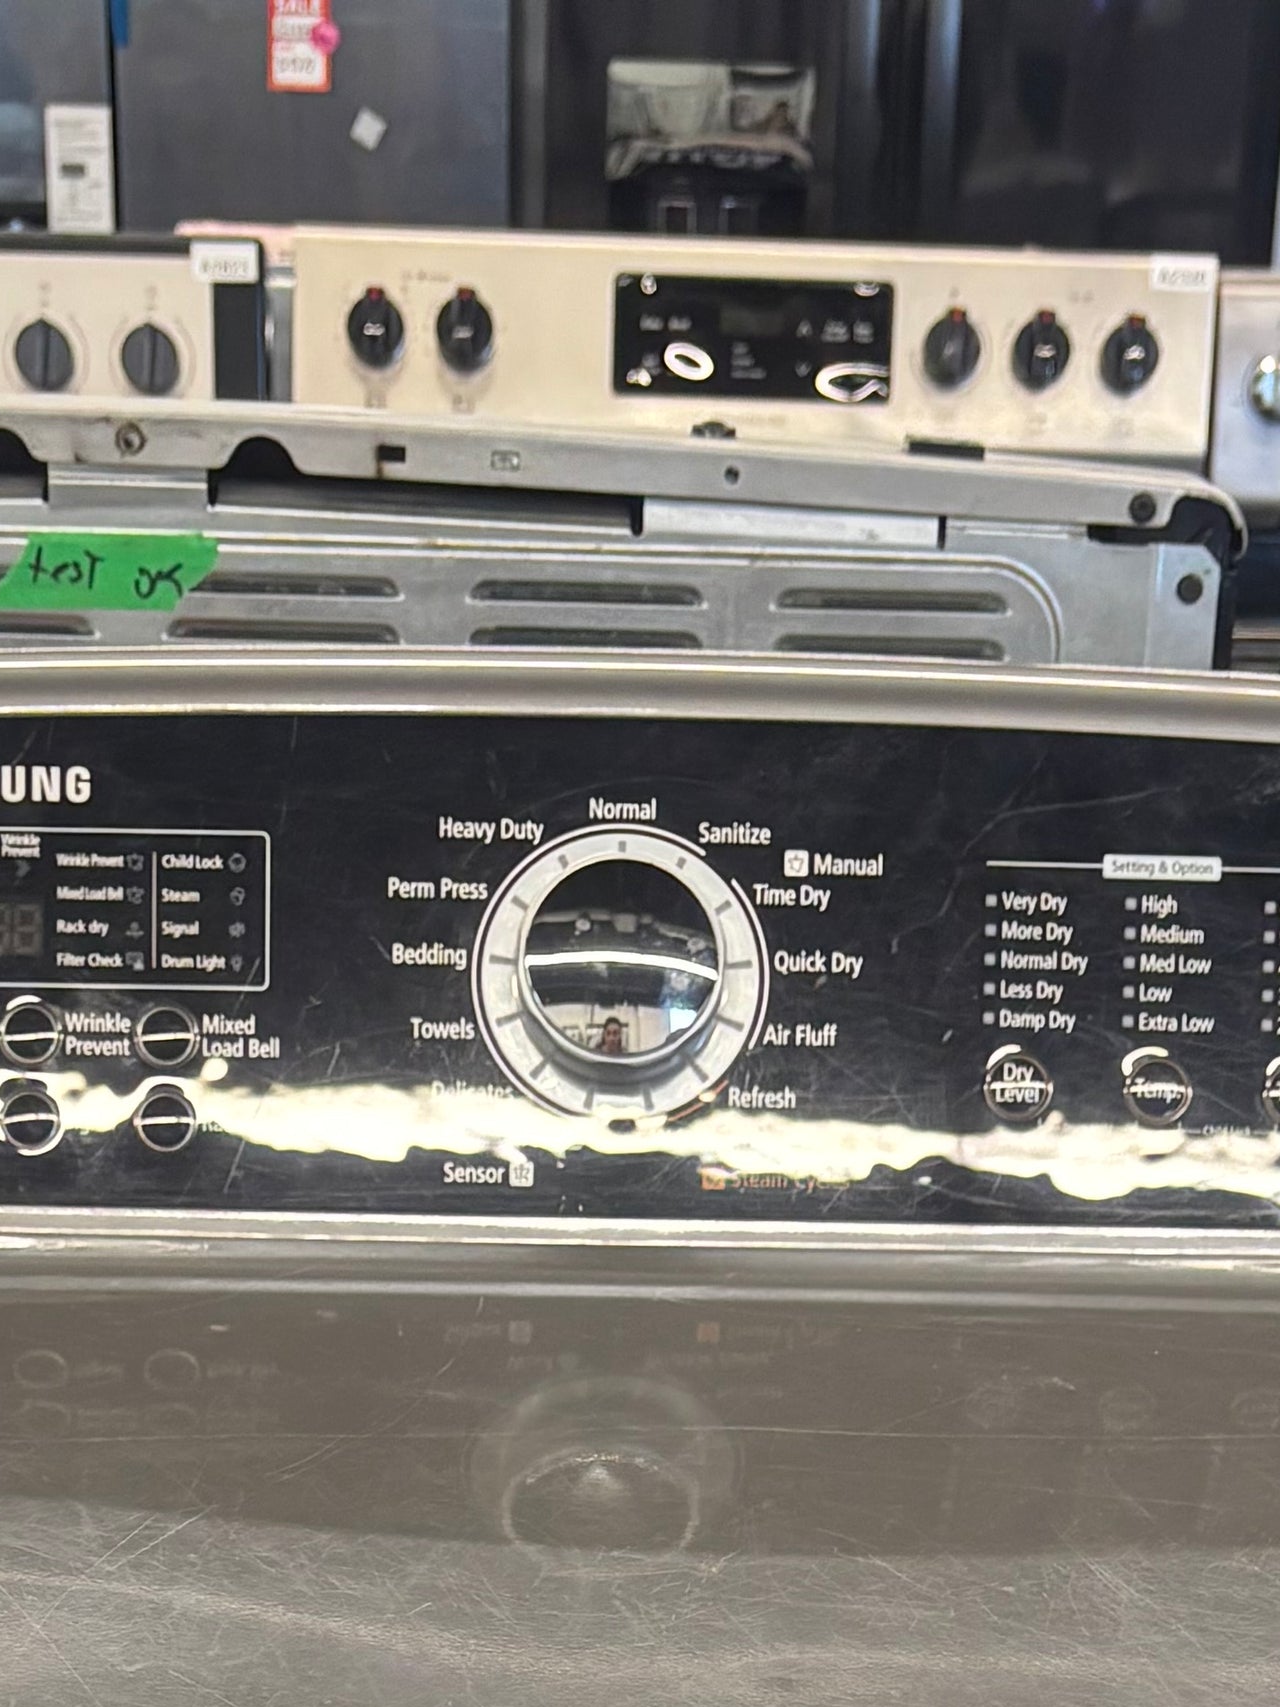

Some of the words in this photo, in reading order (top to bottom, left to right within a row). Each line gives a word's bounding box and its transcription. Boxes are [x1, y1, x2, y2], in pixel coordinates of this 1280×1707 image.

[589, 798, 657, 820] Normal
[439, 817, 495, 844] Heavy
[500, 820, 543, 845] Duty
[698, 822, 771, 845] Sanitize
[161, 854, 193, 869] Child
[195, 855, 224, 870] Lock
[813, 854, 884, 877] Manual
[1111, 859, 1155, 877] Setting
[1158, 860, 1168, 875] &
[1172, 861, 1213, 878] Option
[161, 888, 200, 902] Steam
[387, 877, 436, 899] Perm
[440, 878, 488, 901] Press
[753, 884, 795, 907] Time
[798, 886, 830, 911] Dry
[1002, 891, 1036, 915] Very
[1040, 893, 1067, 916] Dry
[1141, 895, 1178, 919] High
[56, 919, 86, 934] Rack
[88, 919, 109, 937] dry
[161, 921, 200, 938] Signal
[1001, 921, 1042, 941] More
[1046, 923, 1073, 945] Dry
[1140, 925, 1204, 945] Medium
[56, 952, 85, 968] Filter
[88, 953, 124, 968] Check
[161, 955, 194, 969] Drum
[196, 955, 226, 972] Light
[391, 943, 467, 970] Bedding
[773, 952, 826, 975] Quick
[830, 953, 863, 980] Dry
[1001, 950, 1057, 970] Normal
[1061, 953, 1088, 976] Dry
[1140, 953, 1175, 974] Med
[1178, 955, 1212, 974] Low
[999, 979, 1033, 999] Less
[1035, 981, 1063, 1004] Dry
[1139, 983, 1172, 1003] Low
[65, 1011, 132, 1034] Wrinkle
[202, 1013, 255, 1035] Mixed
[410, 1018, 475, 1041] Towels
[999, 1009, 1045, 1032] Damp
[1048, 1011, 1076, 1034] Dry
[1138, 1012, 1178, 1032] Extra
[1181, 1014, 1215, 1034] Low
[65, 1036, 130, 1056] Prevent
[763, 1023, 792, 1046] Air
[795, 1024, 837, 1047] Fluff
[202, 1037, 244, 1058] Load
[248, 1037, 280, 1058] Bell
[1003, 1062, 1033, 1085] Dry
[728, 1084, 796, 1109] Refresh
[995, 1086, 1040, 1104] Level
[443, 1161, 506, 1183] Sensor
